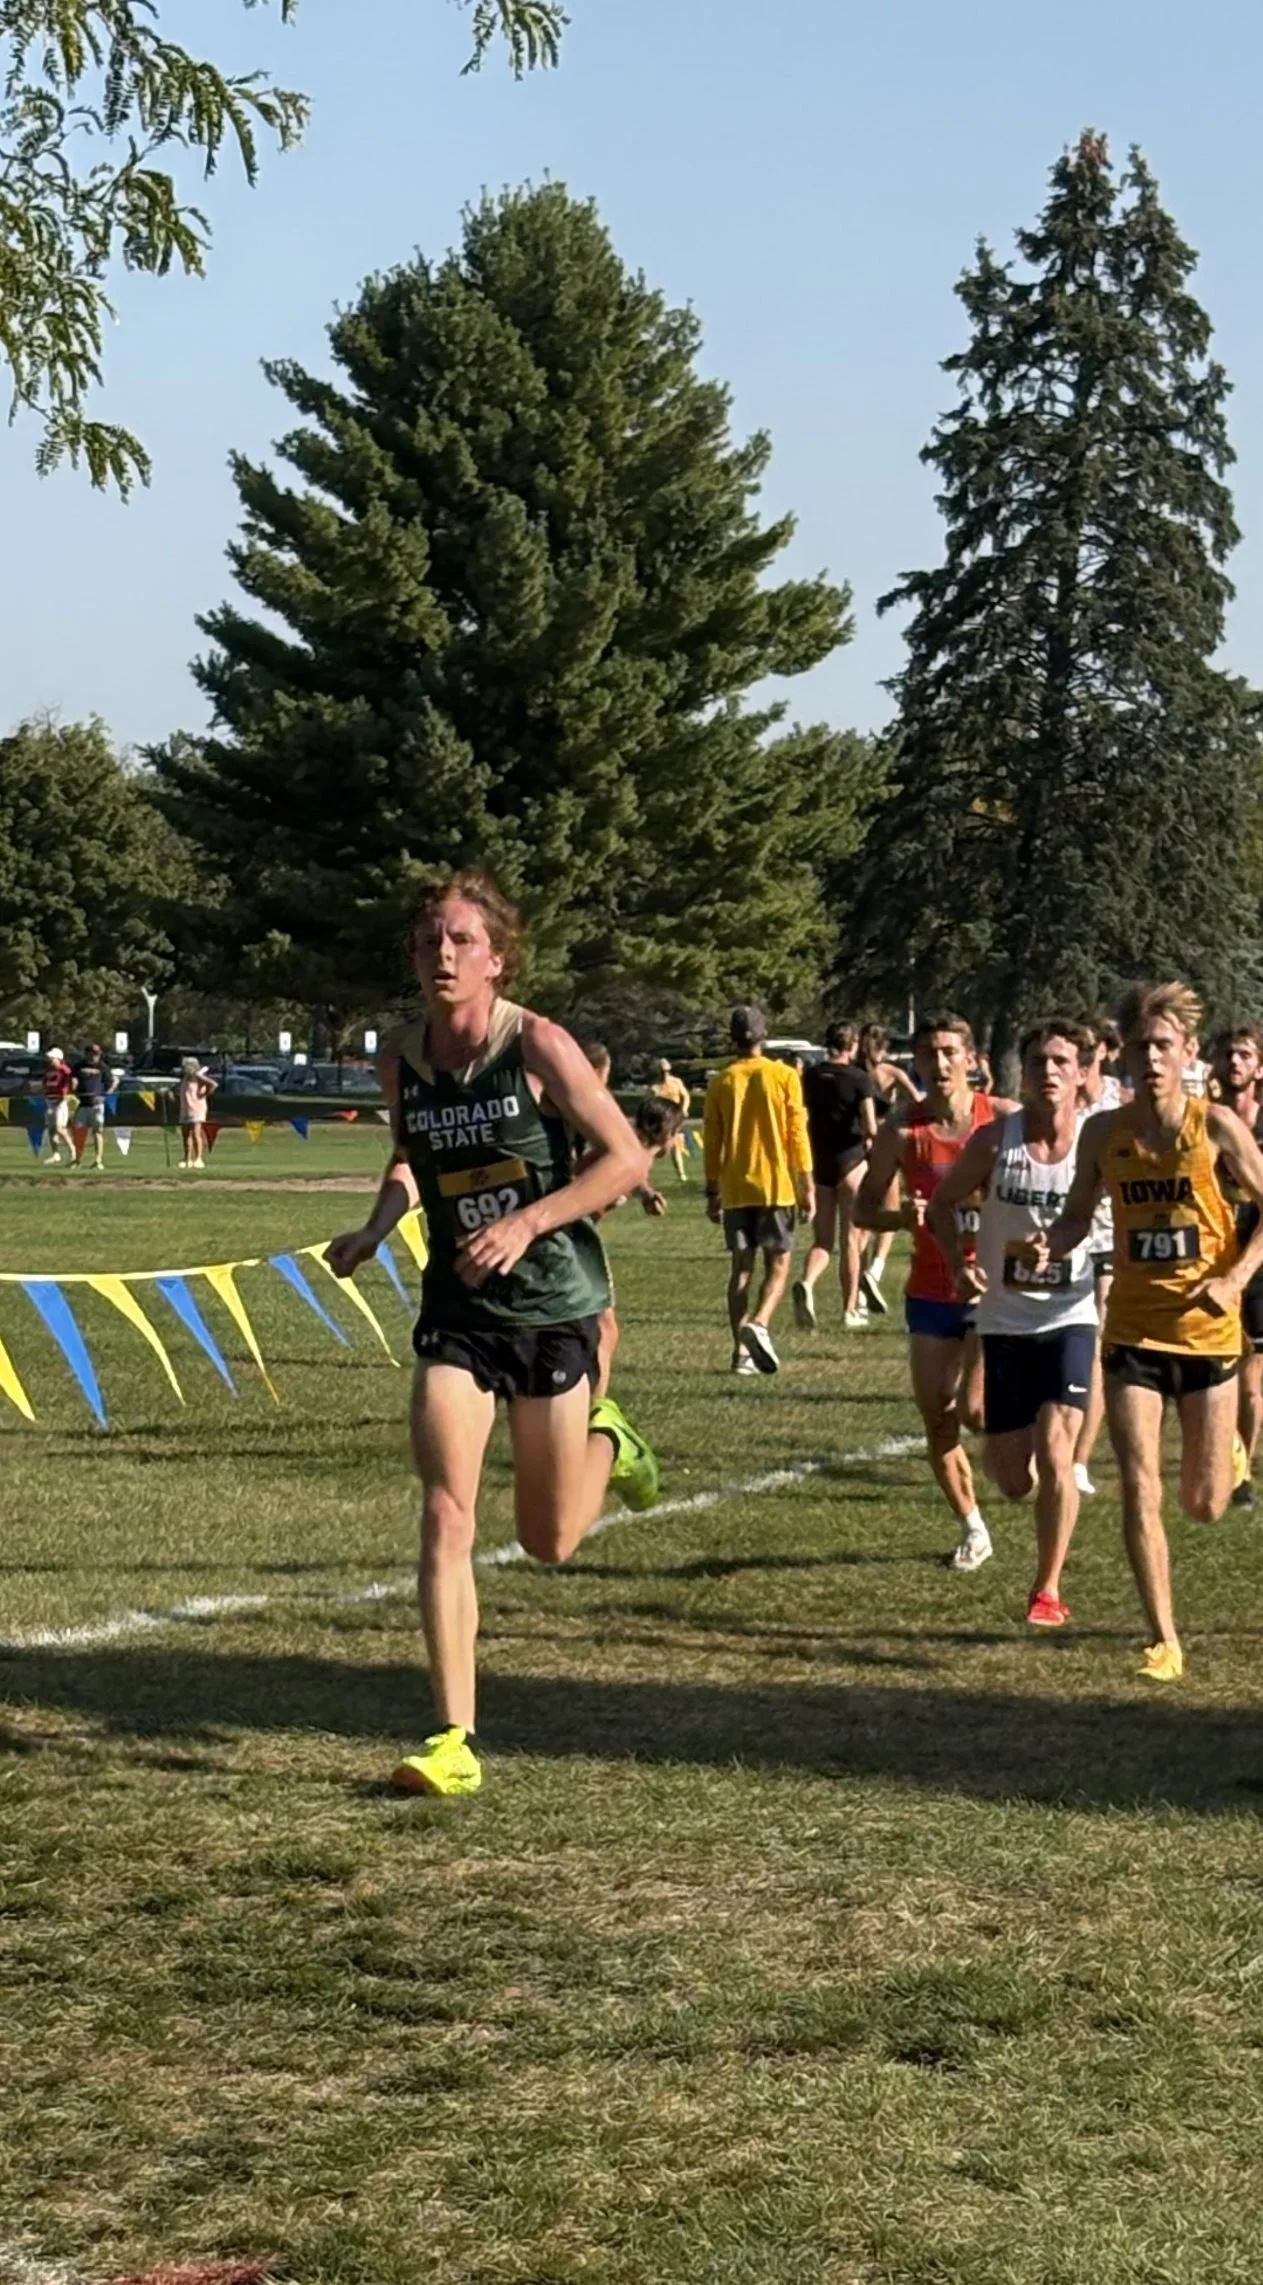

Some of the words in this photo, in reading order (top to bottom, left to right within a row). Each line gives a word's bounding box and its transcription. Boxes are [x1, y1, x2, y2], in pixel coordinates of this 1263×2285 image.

[406, 1095, 520, 1133] COLORADO
[429, 1122, 495, 1151] STATE
[1120, 1177, 1194, 1205] IOWA
[457, 1187, 520, 1230] 692
[1136, 1231, 1188, 1260] 791
